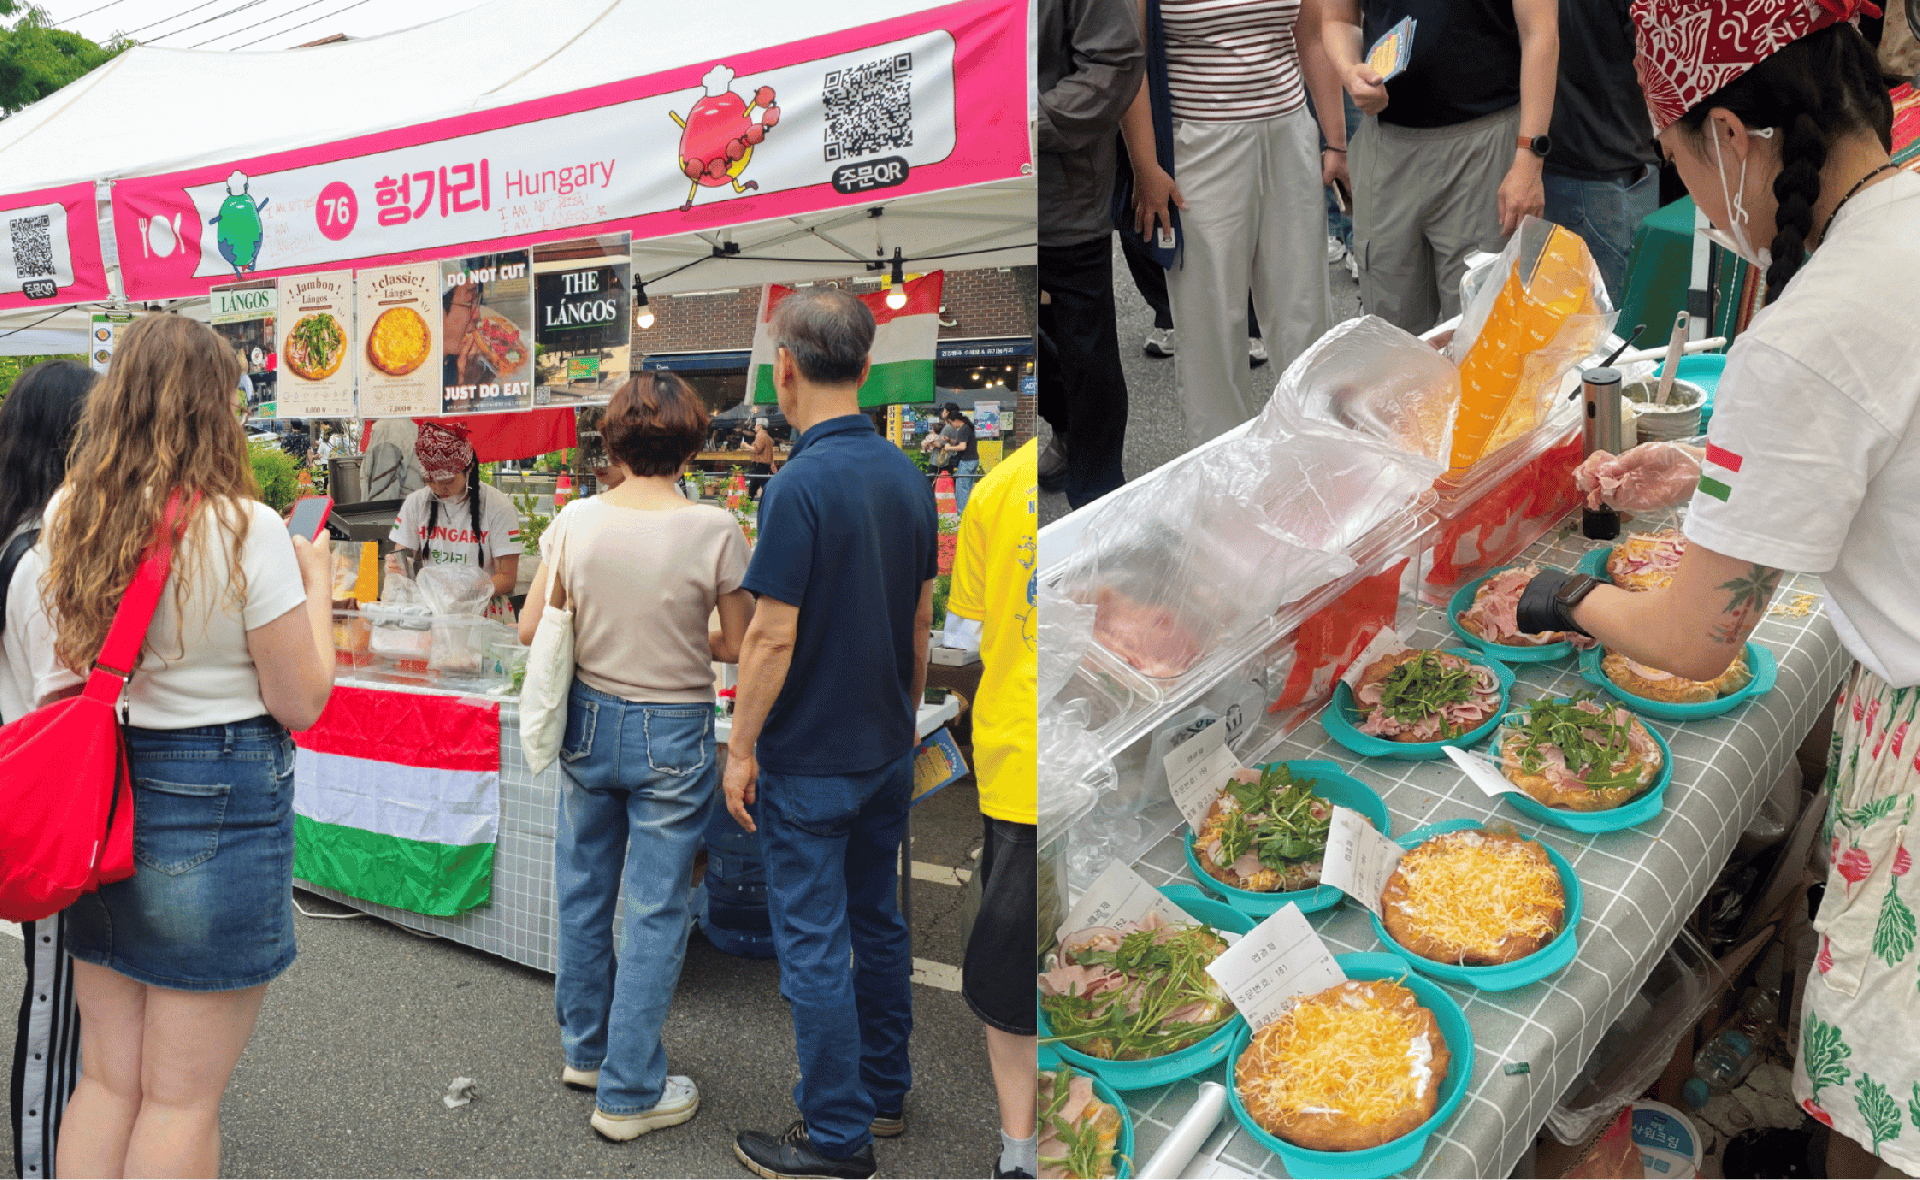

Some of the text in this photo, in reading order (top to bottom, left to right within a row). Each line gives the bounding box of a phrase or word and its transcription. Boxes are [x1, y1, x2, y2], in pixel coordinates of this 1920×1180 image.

[839, 161, 904, 191] 주문QR
[373, 158, 616, 227] 헝가리 Hungary
[323, 196, 350, 226] 76
[447, 264, 526, 287] DO NOT CUT
[561, 270, 600, 295] THE
[545, 298, 617, 327] LÁNGOS
[444, 382, 530, 401] JUST DO EAT
[431, 549, 468, 565] 헝가리
